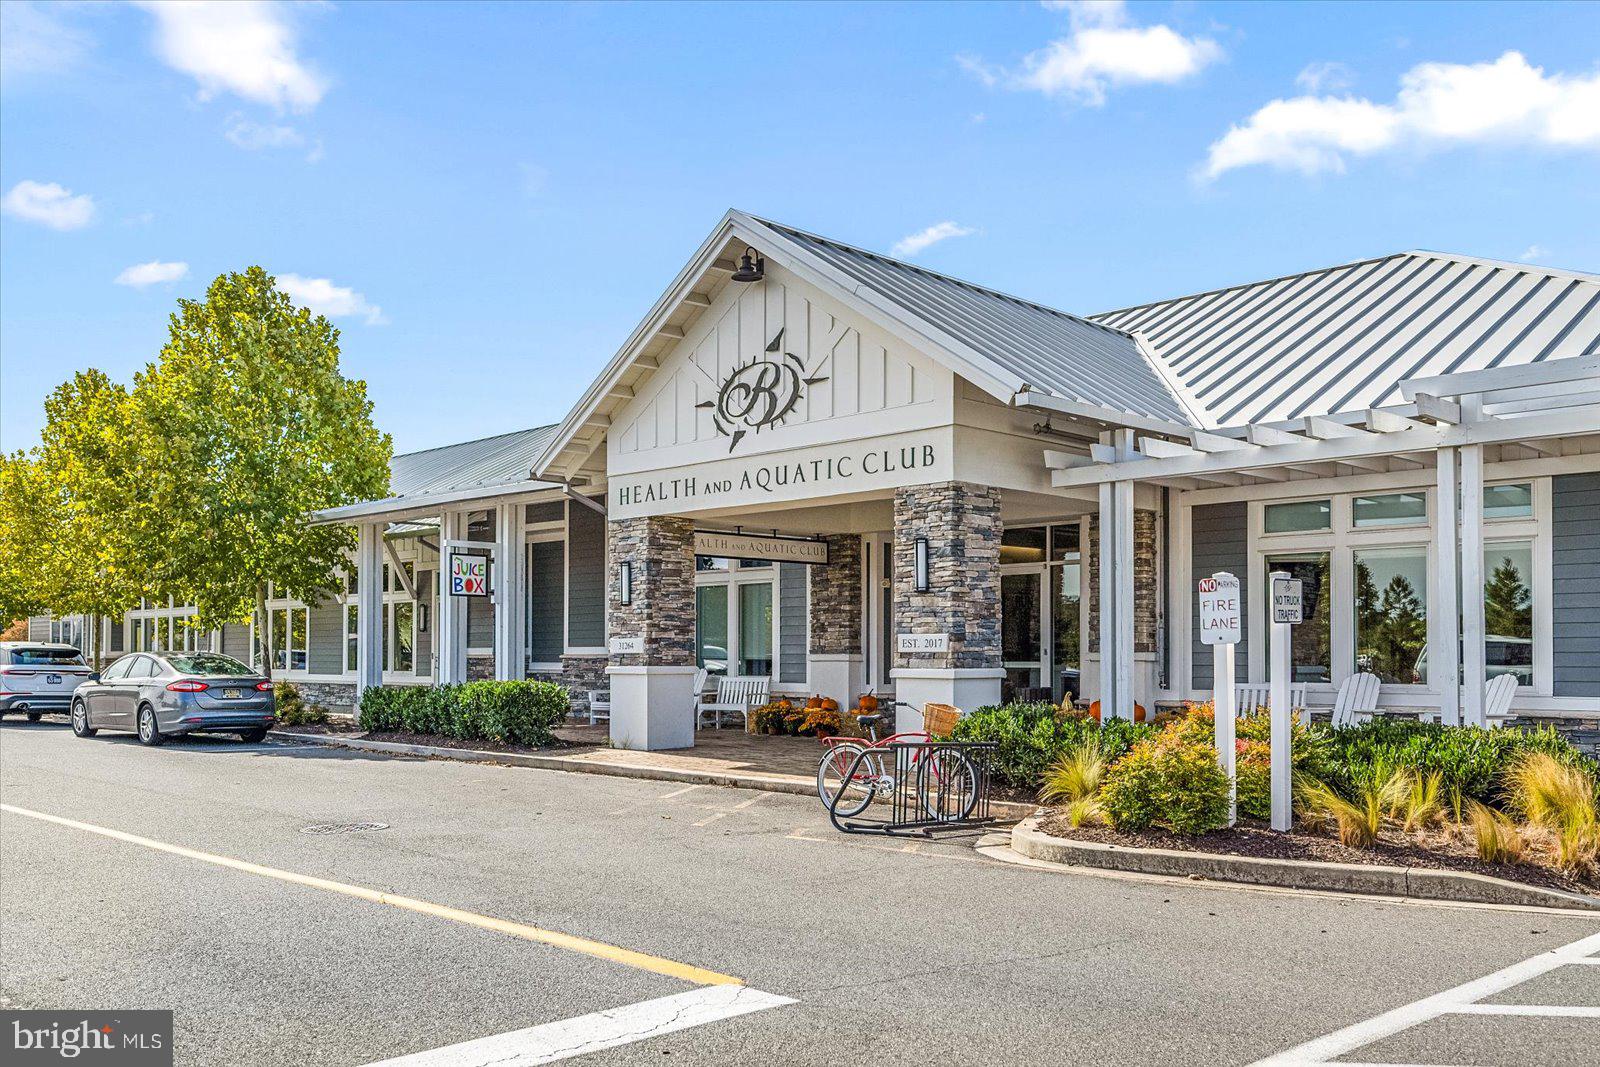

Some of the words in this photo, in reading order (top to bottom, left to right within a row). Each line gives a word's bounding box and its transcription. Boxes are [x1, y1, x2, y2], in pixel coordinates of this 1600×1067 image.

[619, 477, 696, 505] HEALTH
[703, 480, 733, 495] AND
[740, 456, 853, 492] AQUATIC
[862, 445, 935, 475] CLUB
[696, 538, 729, 550] ALTH
[749, 541, 798, 555] AQUATIC
[799, 545, 826, 557] CLUB
[453, 556, 485, 577] JUICE
[453, 576, 485, 594] BOX
[1200, 580, 1217, 592] NO
[1202, 599, 1237, 611] FIRE
[1275, 595, 1283, 605] NO
[1283, 595, 1300, 605] TRUCK
[1278, 609, 1298, 619] TRAFFIC
[1202, 617, 1238, 630] LANE
[902, 639, 920, 648] EST.
[924, 639, 943, 648] 2017
